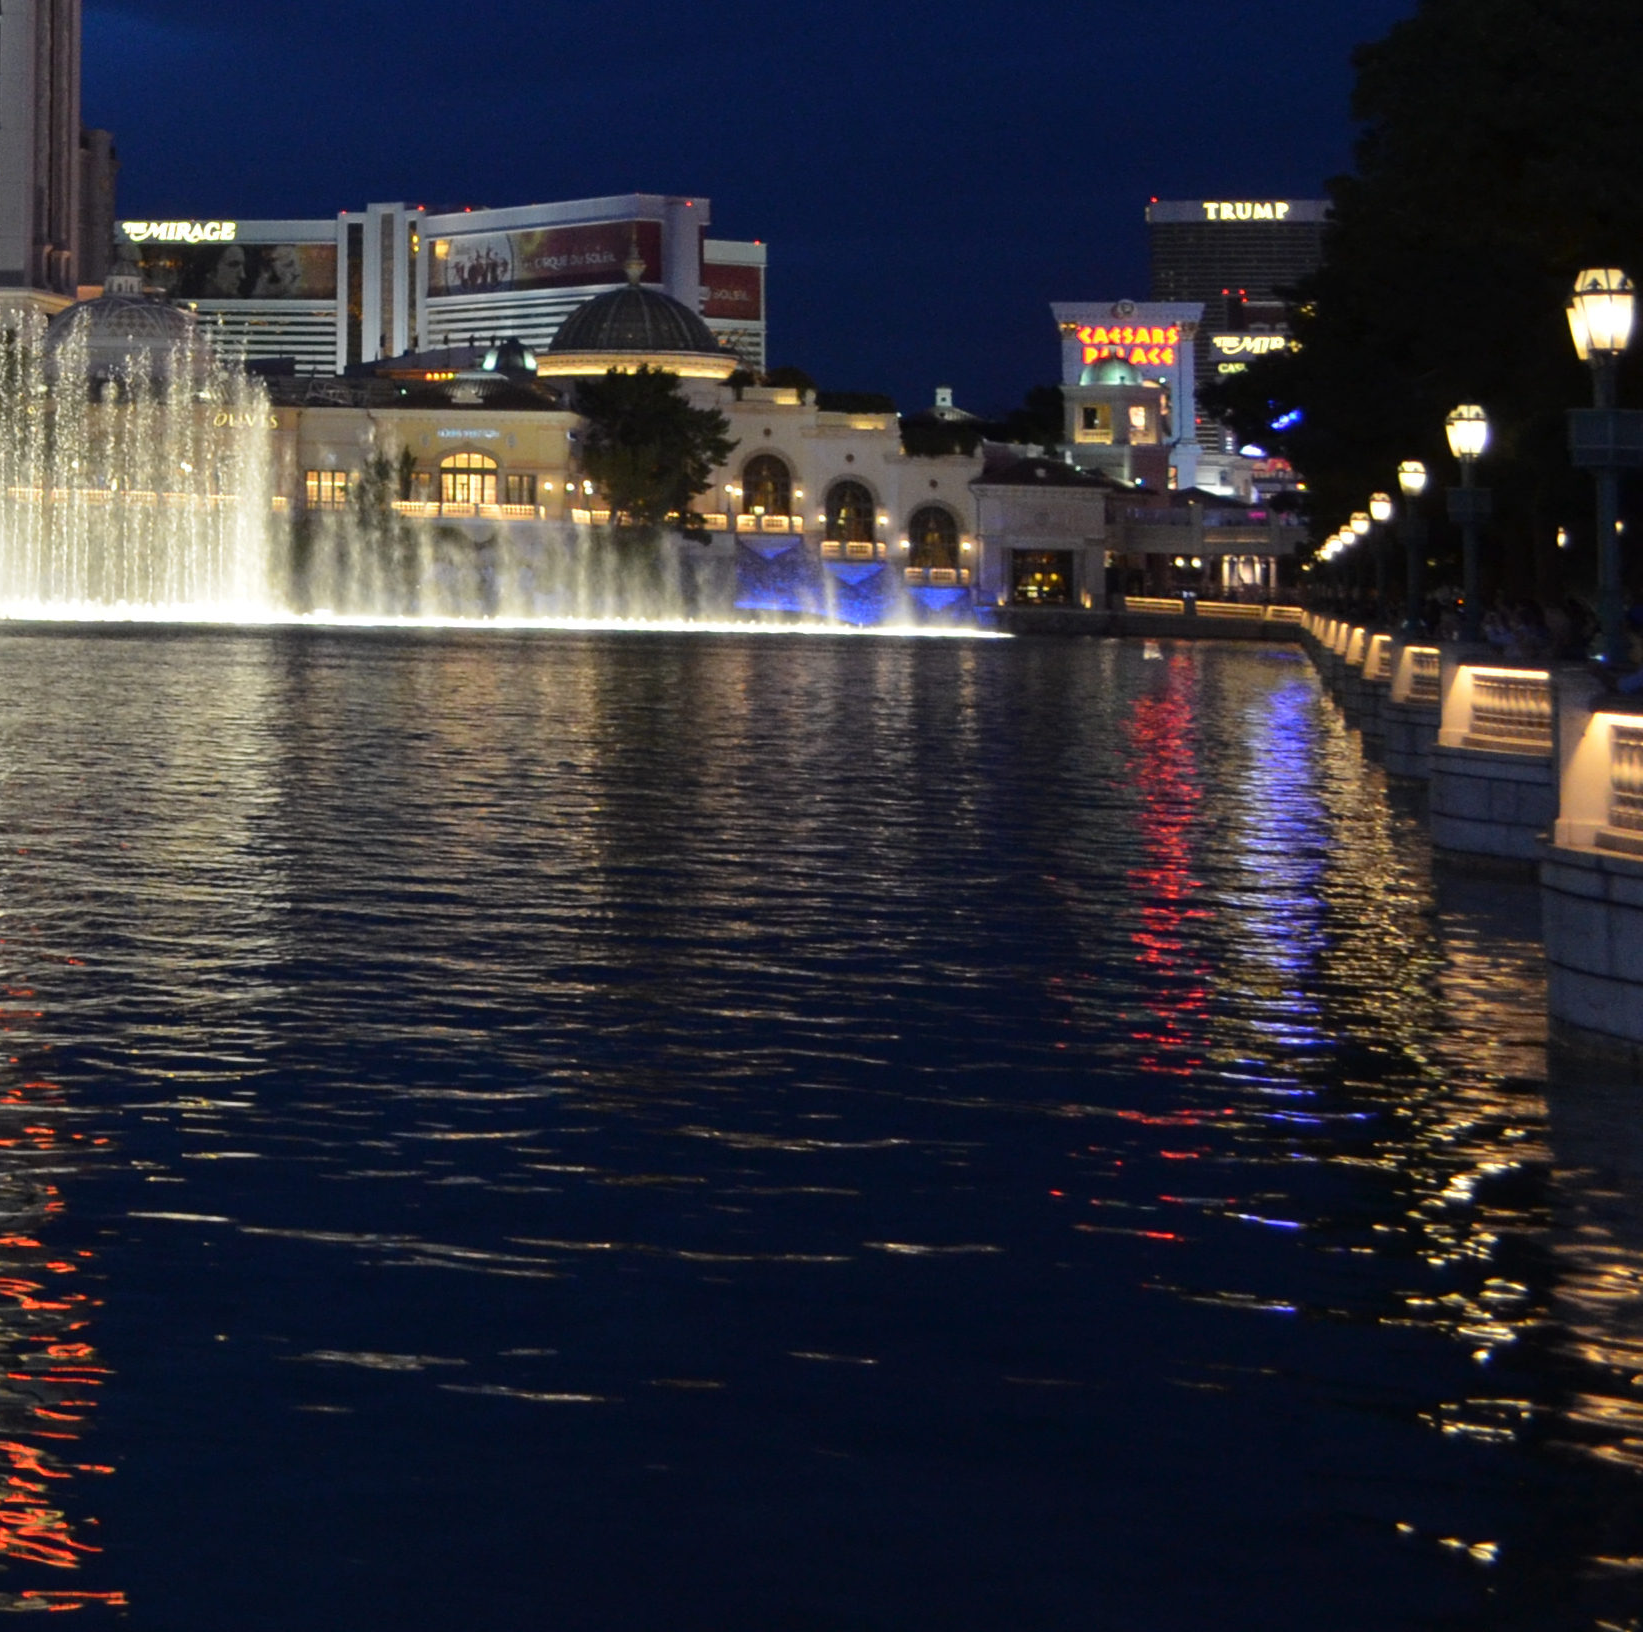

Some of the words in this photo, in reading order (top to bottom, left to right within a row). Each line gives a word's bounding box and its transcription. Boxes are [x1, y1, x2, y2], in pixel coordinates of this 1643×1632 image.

[1202, 201, 1289, 220] TRUMP
[129, 221, 236, 243] MIRAGE
[1077, 326, 1180, 346] CAESARS
[1222, 335, 1286, 355] MIR
